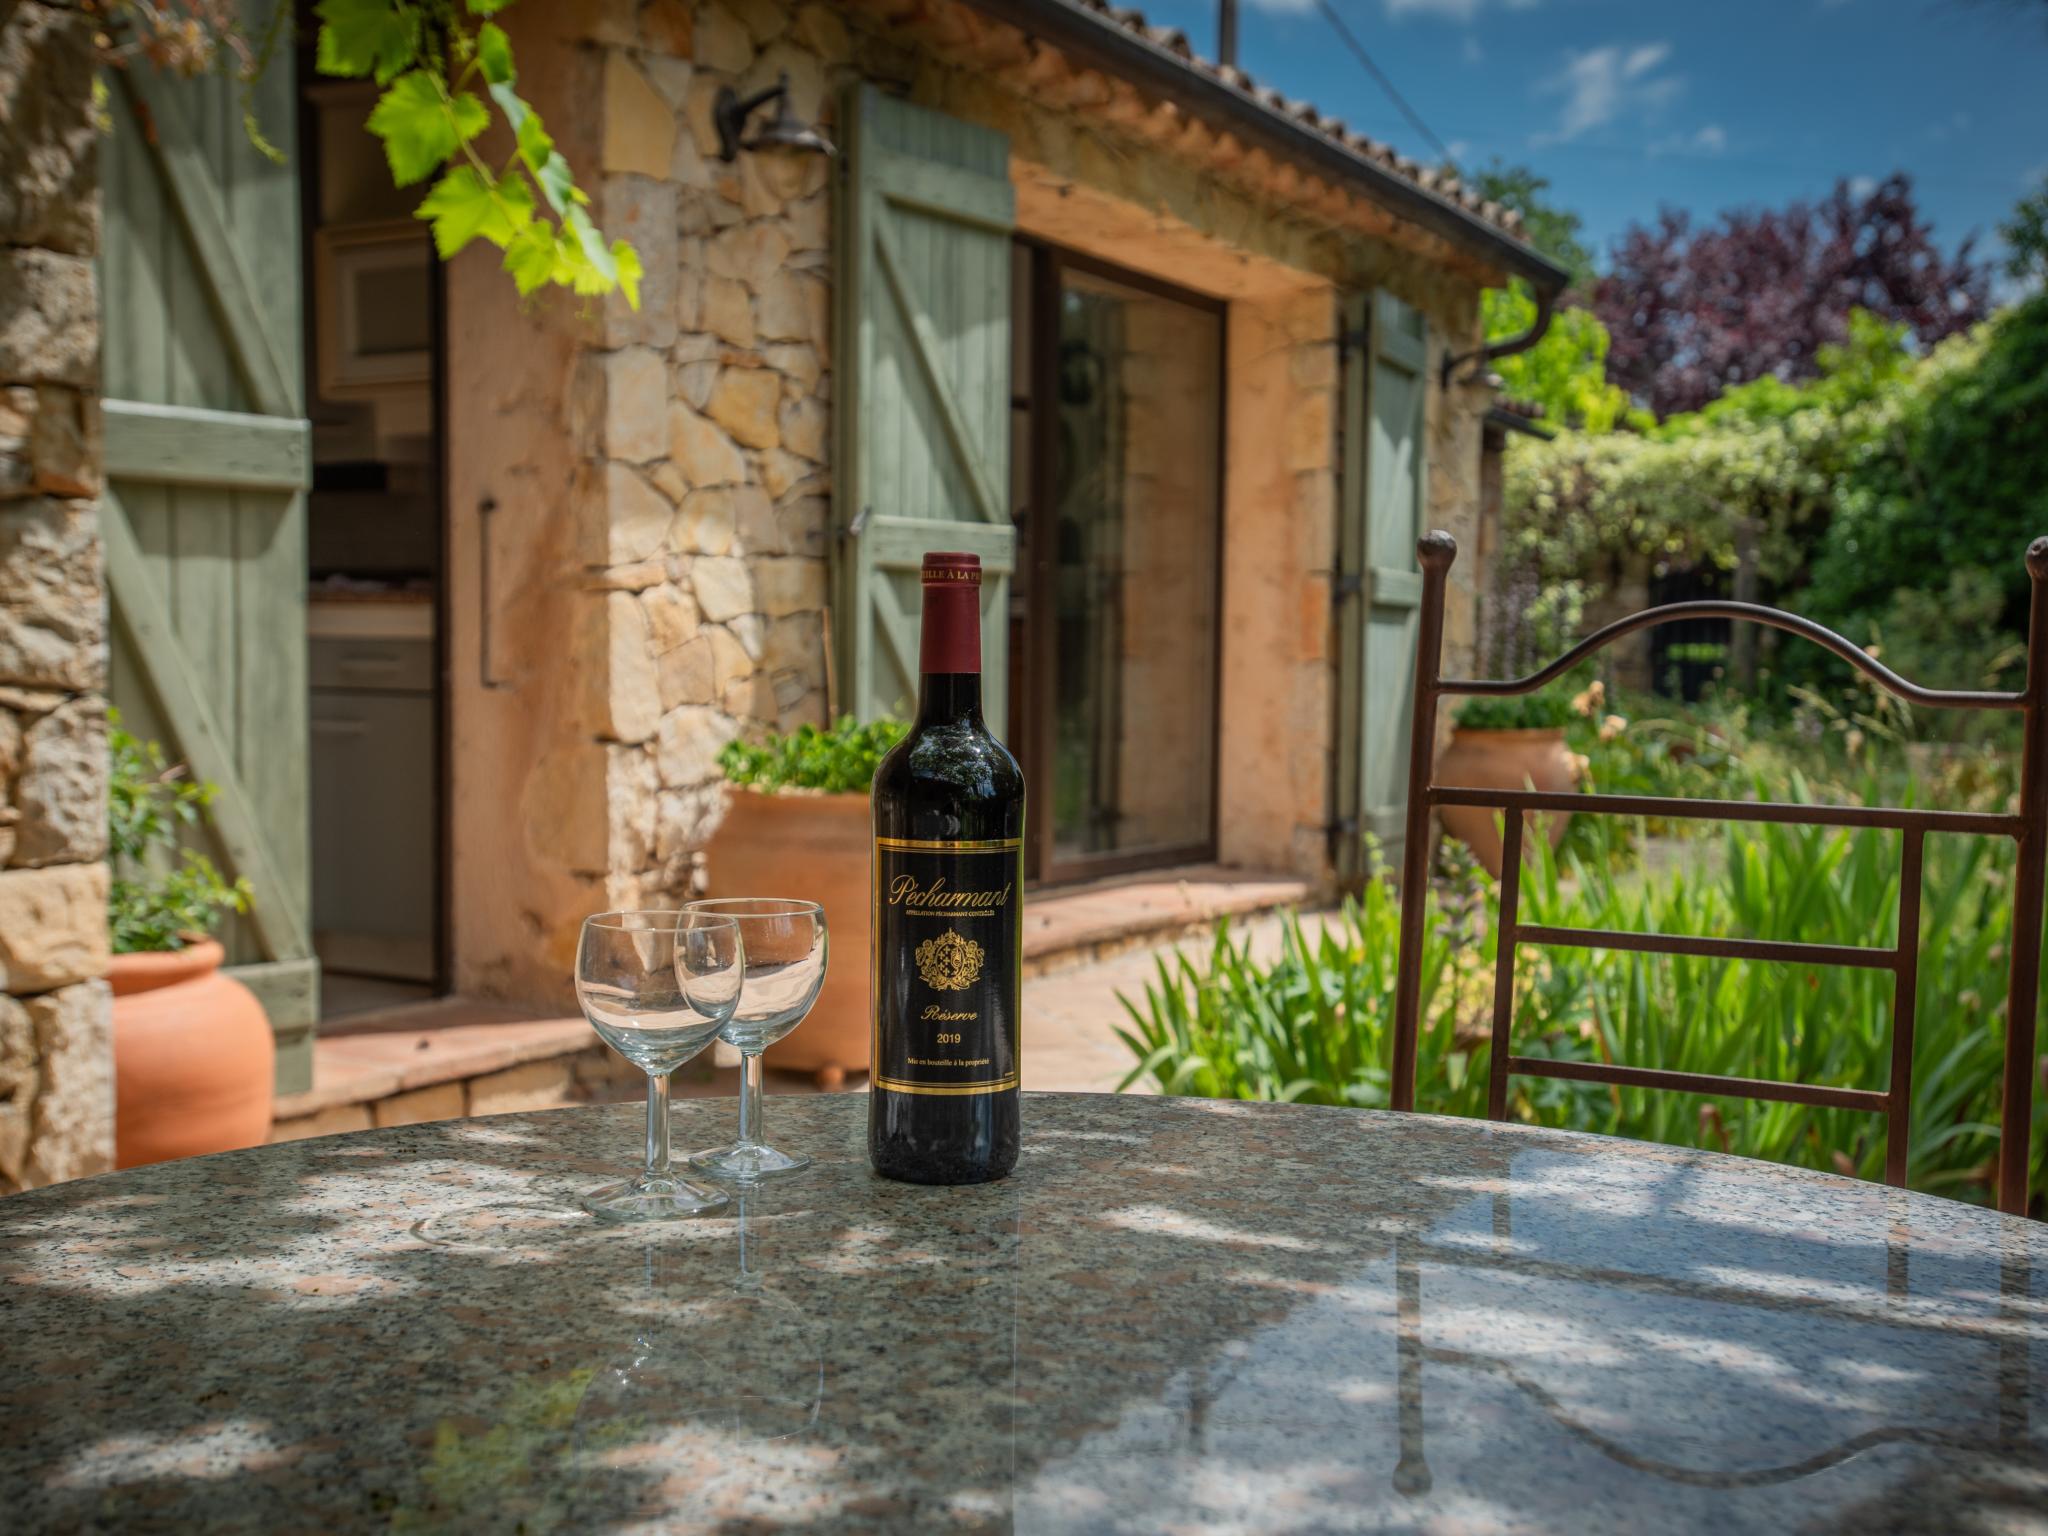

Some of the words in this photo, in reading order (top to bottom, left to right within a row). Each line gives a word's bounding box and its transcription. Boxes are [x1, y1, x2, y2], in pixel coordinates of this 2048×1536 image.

[957, 570, 969, 580] LA
[889, 874, 1012, 907] Pécharmant
[920, 1004, 978, 1021] Réserve
[936, 1033, 961, 1044] 2019
